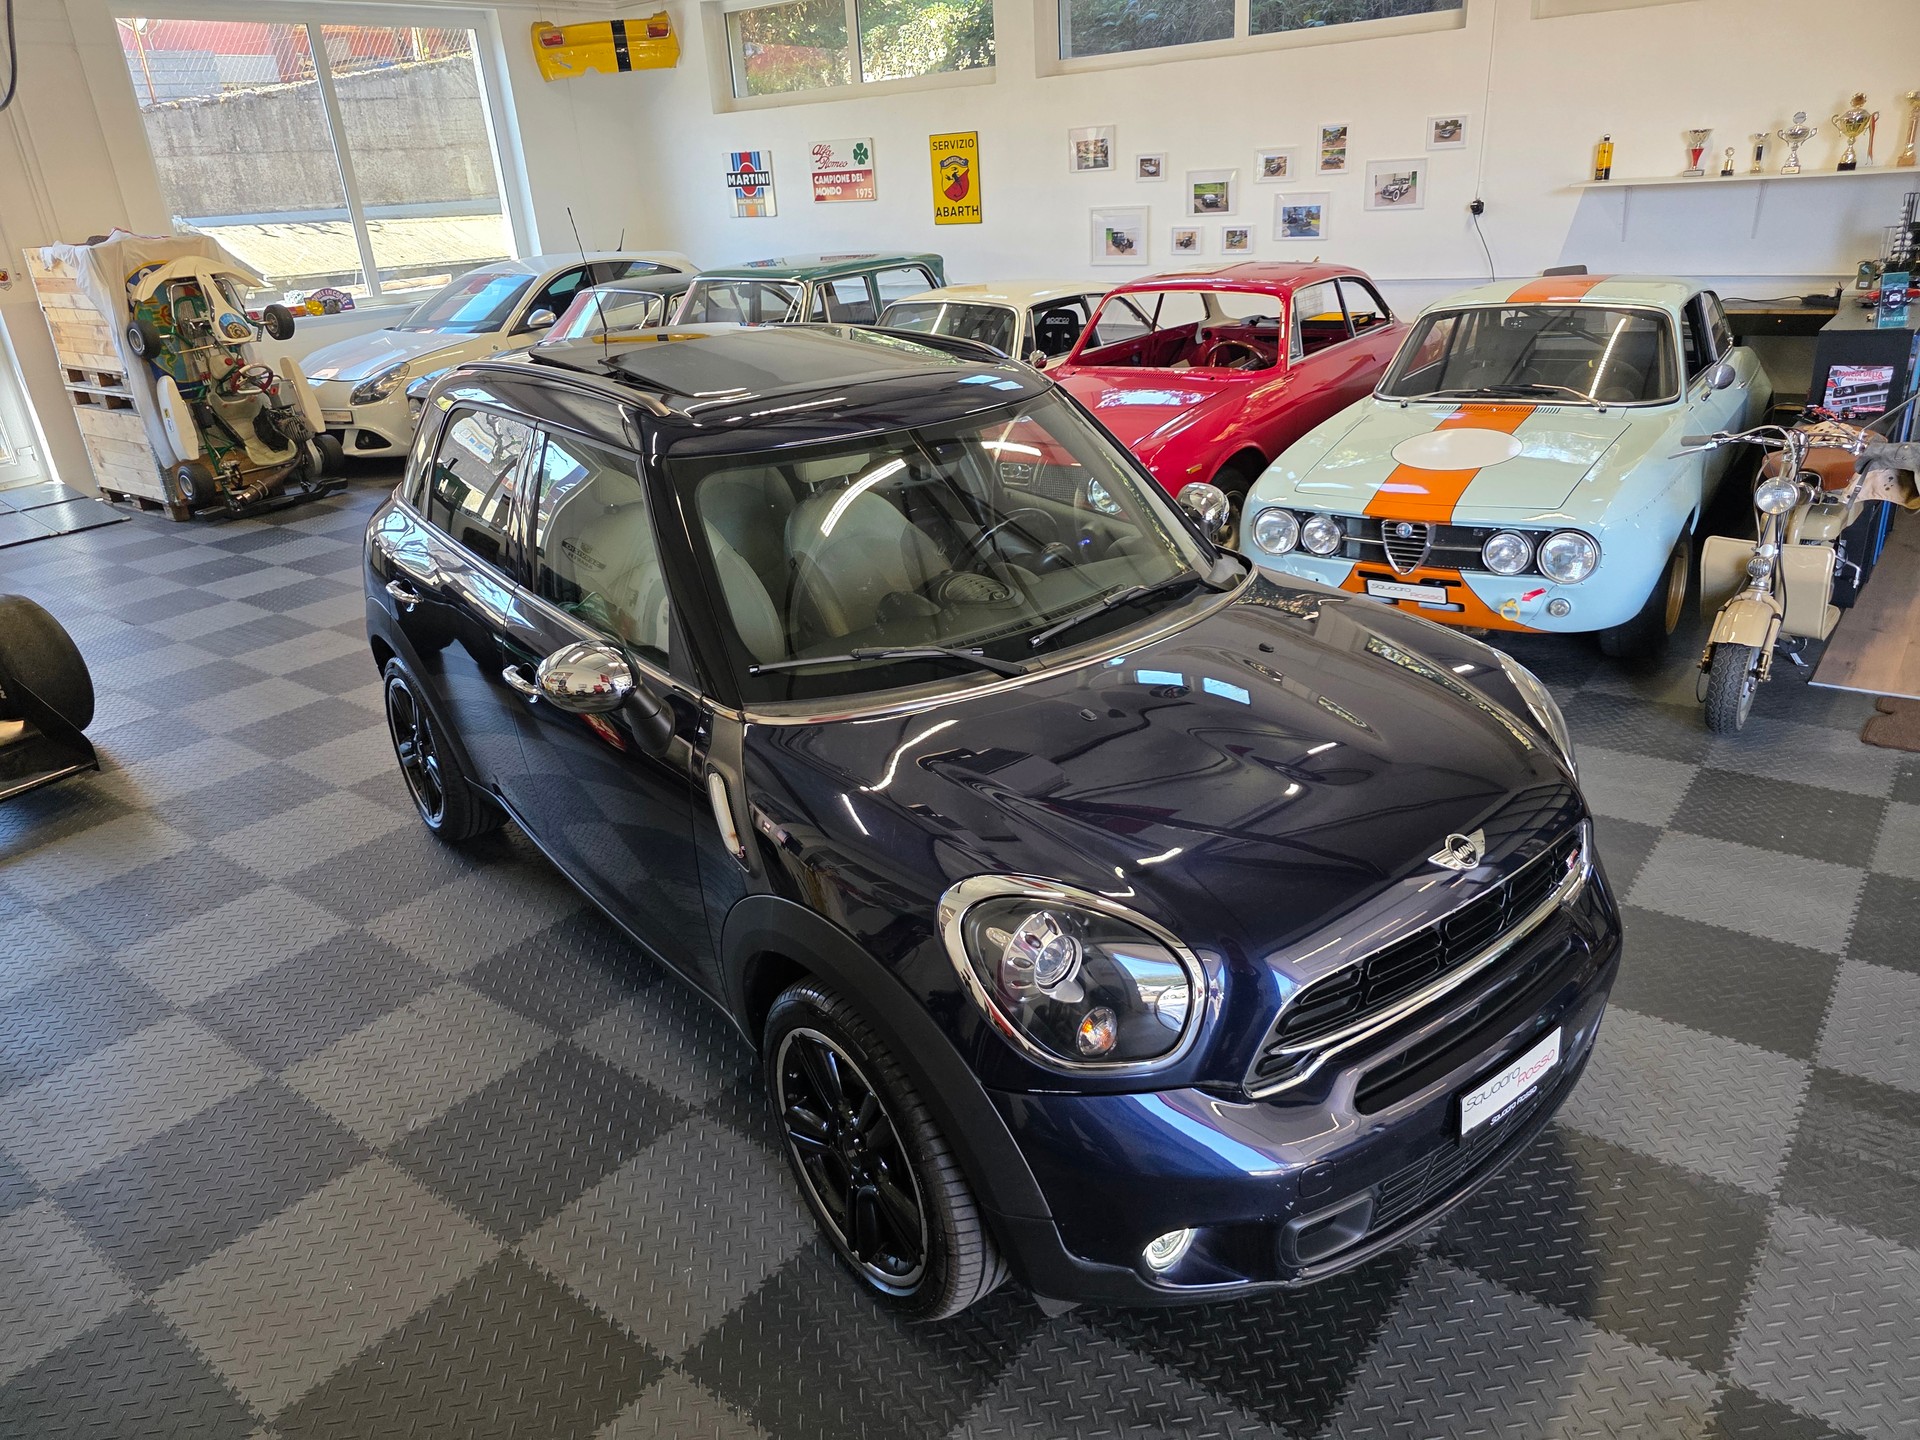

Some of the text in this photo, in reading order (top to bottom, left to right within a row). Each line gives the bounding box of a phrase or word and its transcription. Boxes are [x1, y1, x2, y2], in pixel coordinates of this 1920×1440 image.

[932, 139, 974, 151] SERVIZIO
[812, 144, 834, 163] Alfa
[817, 156, 848, 170] Romeo
[727, 173, 769, 186] MARTINI
[814, 173, 864, 185] CAMPIONE DEL
[815, 186, 873, 199] MONDO 1975
[936, 205, 979, 217] ABARTH
[1463, 1066, 1521, 1113] Squadra
